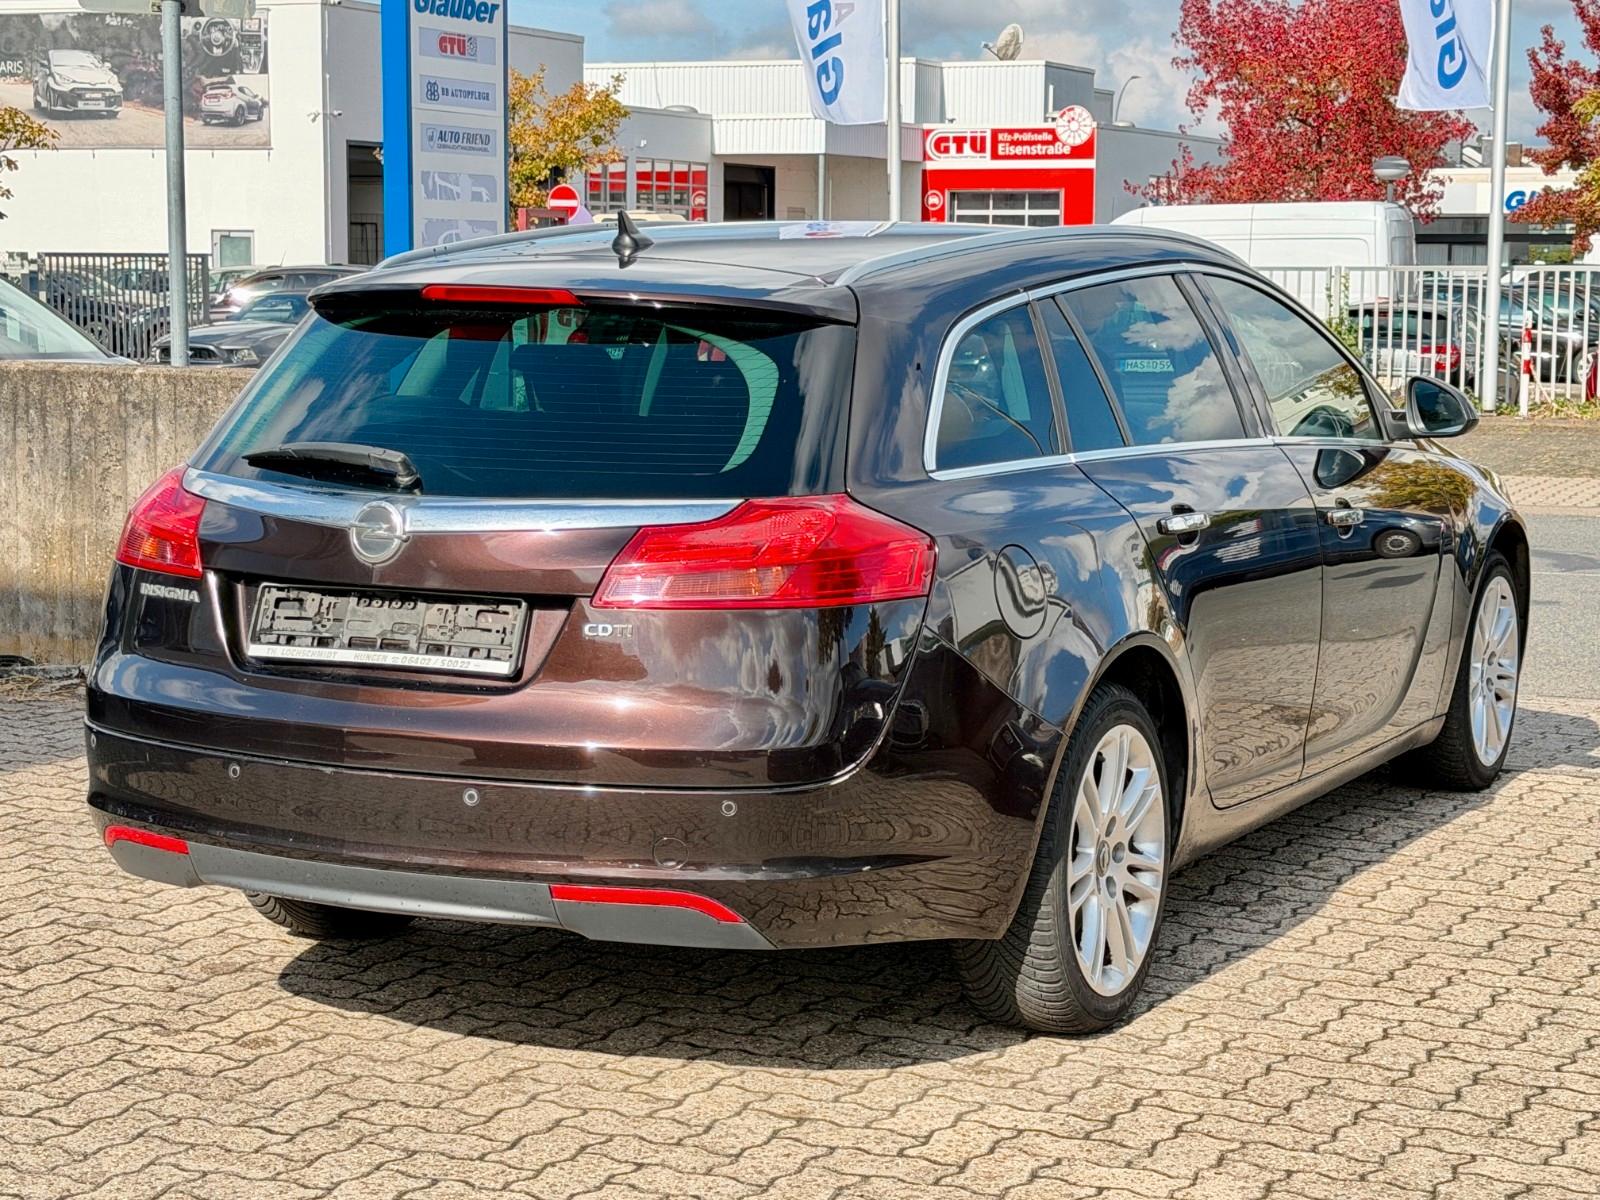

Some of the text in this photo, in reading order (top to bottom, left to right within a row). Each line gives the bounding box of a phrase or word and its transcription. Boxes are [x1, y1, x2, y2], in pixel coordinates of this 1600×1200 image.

[437, 130, 491, 146] AUTO FRIEND
[933, 130, 987, 154] GTÜ
[998, 132, 1053, 142] Kfz-Prüfstelle
[998, 143, 1071, 156] Eisenstraße
[140, 582, 200, 603] INSIGNIA
